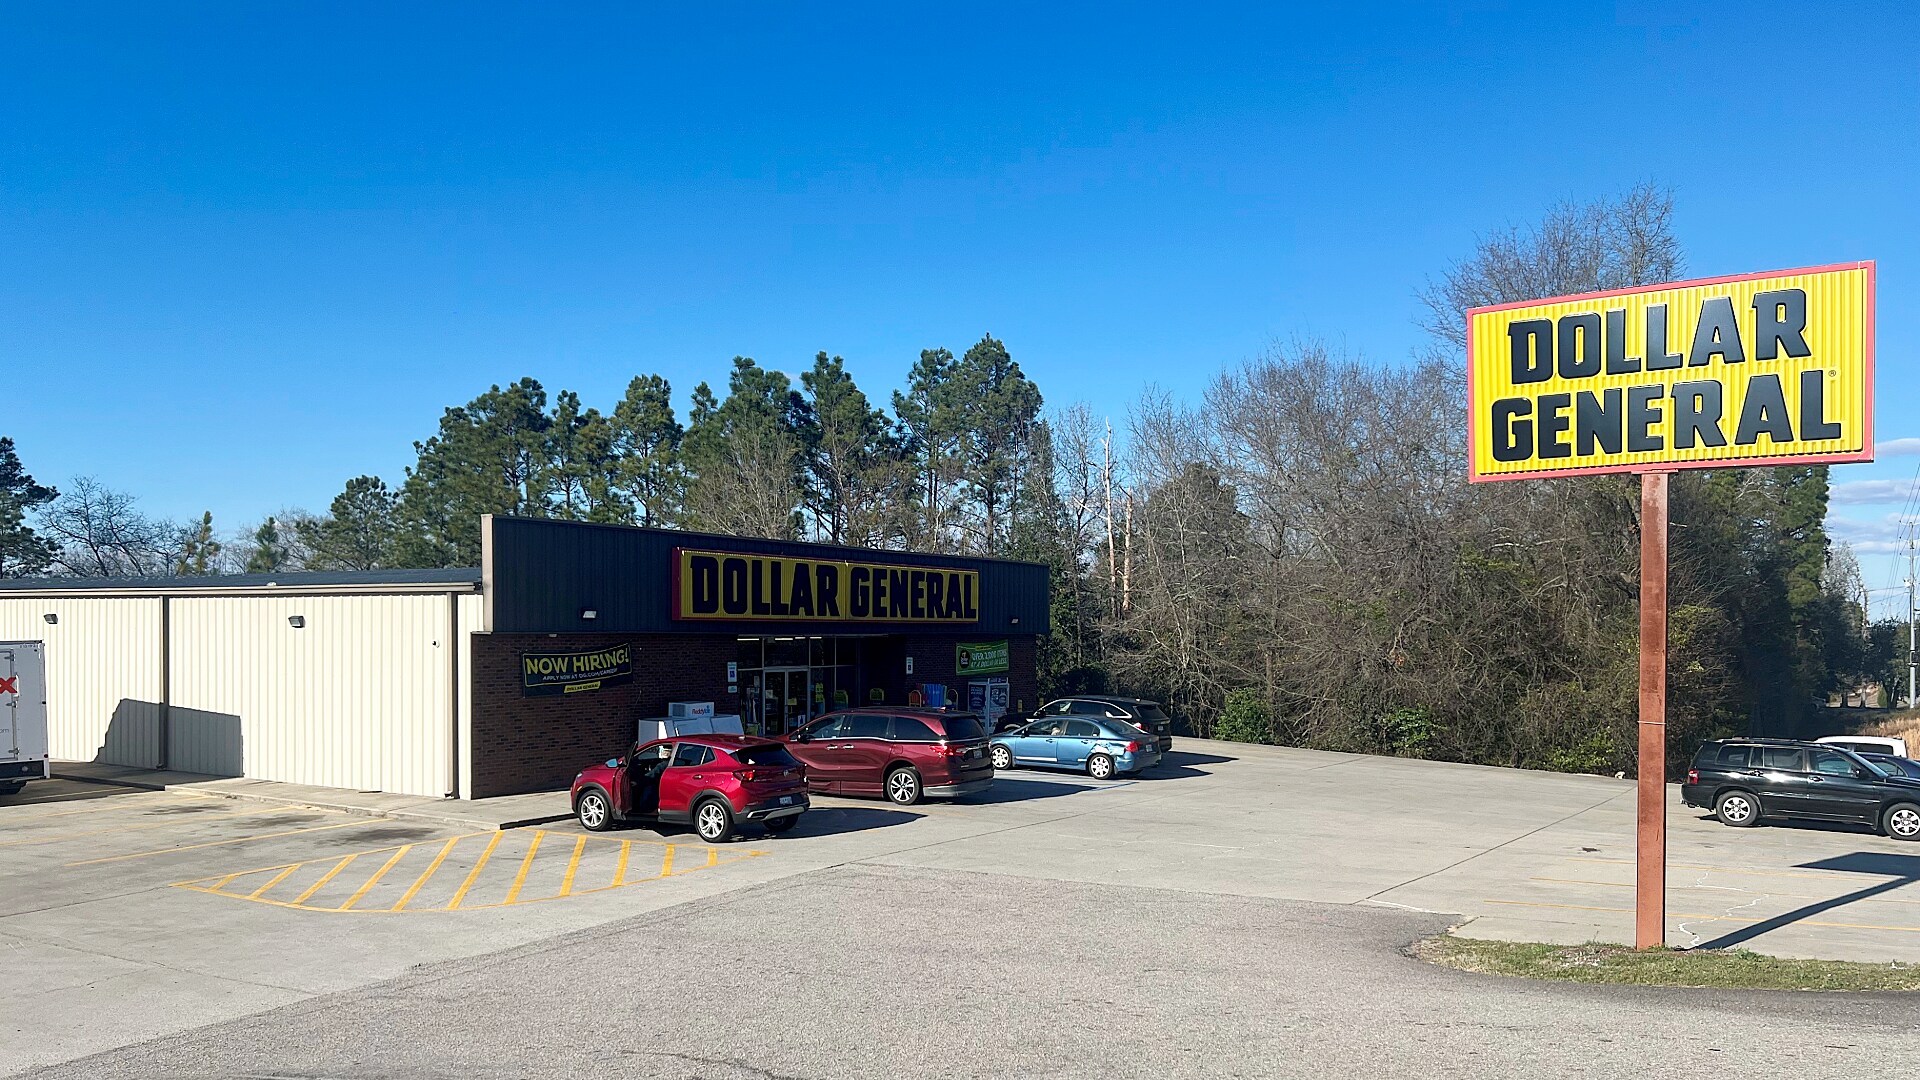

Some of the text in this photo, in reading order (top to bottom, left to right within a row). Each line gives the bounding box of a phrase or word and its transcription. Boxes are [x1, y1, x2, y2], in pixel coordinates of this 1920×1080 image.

[1508, 288, 1811, 384] DOLLAR
[1491, 369, 1841, 462] GENERAL
[690, 556, 977, 619] DOLLAR GENERAL
[526, 648, 630, 675] NOW HIRING!
